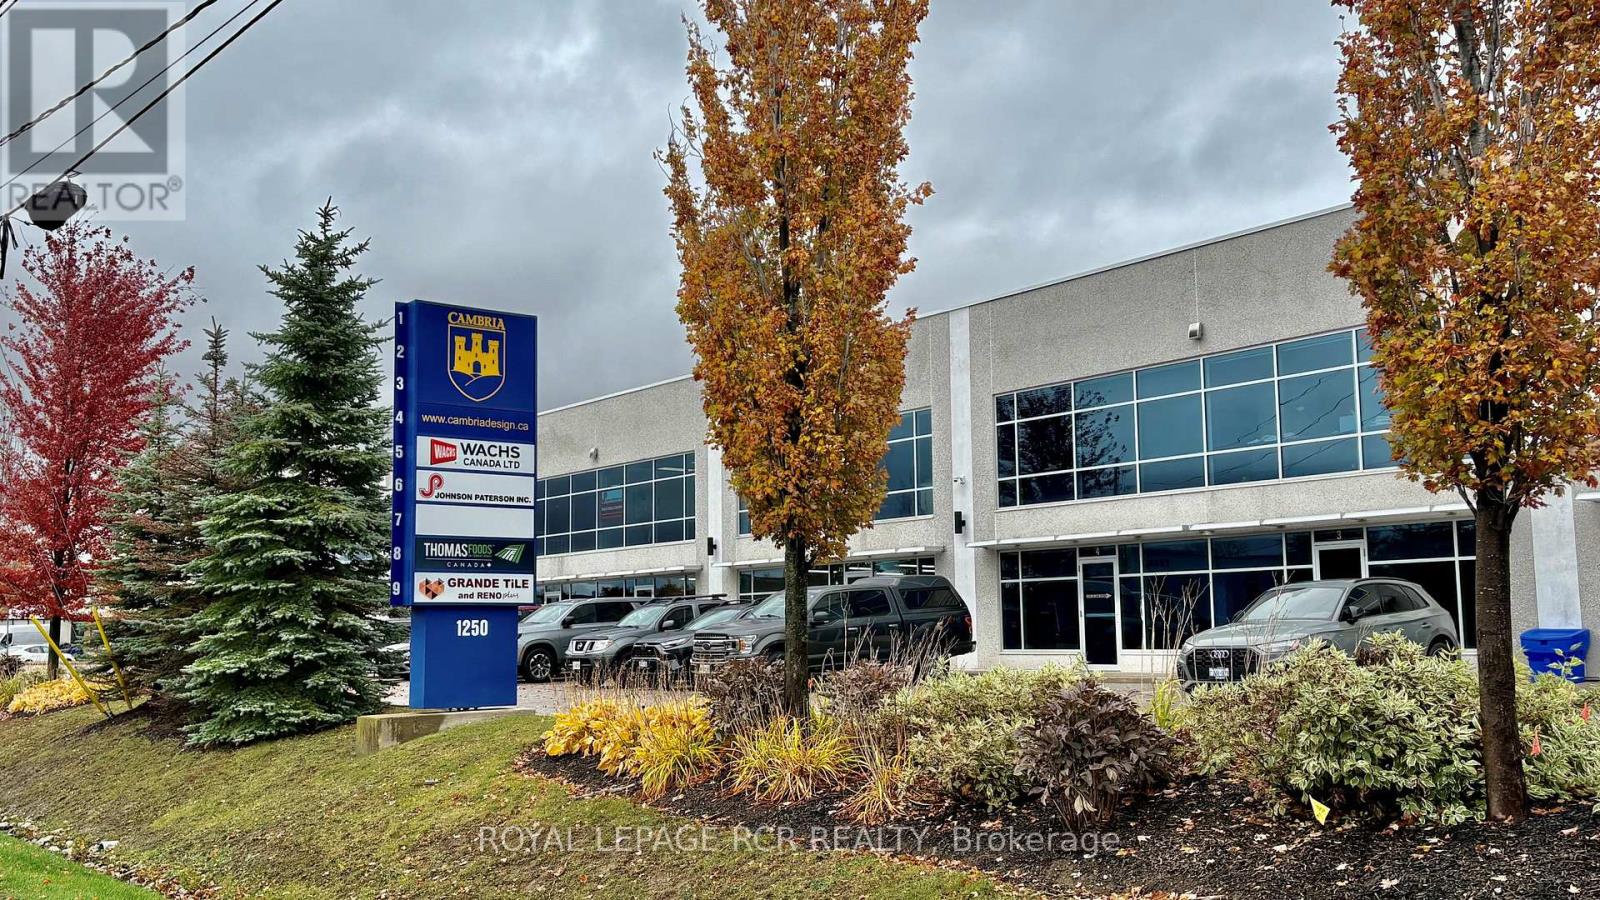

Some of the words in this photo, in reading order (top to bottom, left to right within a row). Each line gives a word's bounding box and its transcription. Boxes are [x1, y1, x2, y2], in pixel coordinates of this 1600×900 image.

[397, 312, 403, 325] 1
[447, 311, 505, 331] CAMBRIA
[396, 345, 405, 359] 2
[396, 376, 404, 390] 3
[395, 410, 404, 425] 4
[421, 414, 529, 431] www.cambriadesign.ca
[395, 445, 404, 459] 5
[460, 442, 521, 459] WACHS
[463, 457, 501, 469] CANADA
[503, 461, 521, 469] LTD
[395, 478, 403, 492] 6
[434, 492, 473, 501] JOHNSON
[474, 494, 515, 503] PATERSON
[516, 496, 532, 504] INC.
[395, 513, 402, 526] 7
[393, 547, 402, 560] 8
[392, 582, 401, 595] 9
[447, 578, 499, 588] GRANDE
[456, 619, 489, 637] 1250
